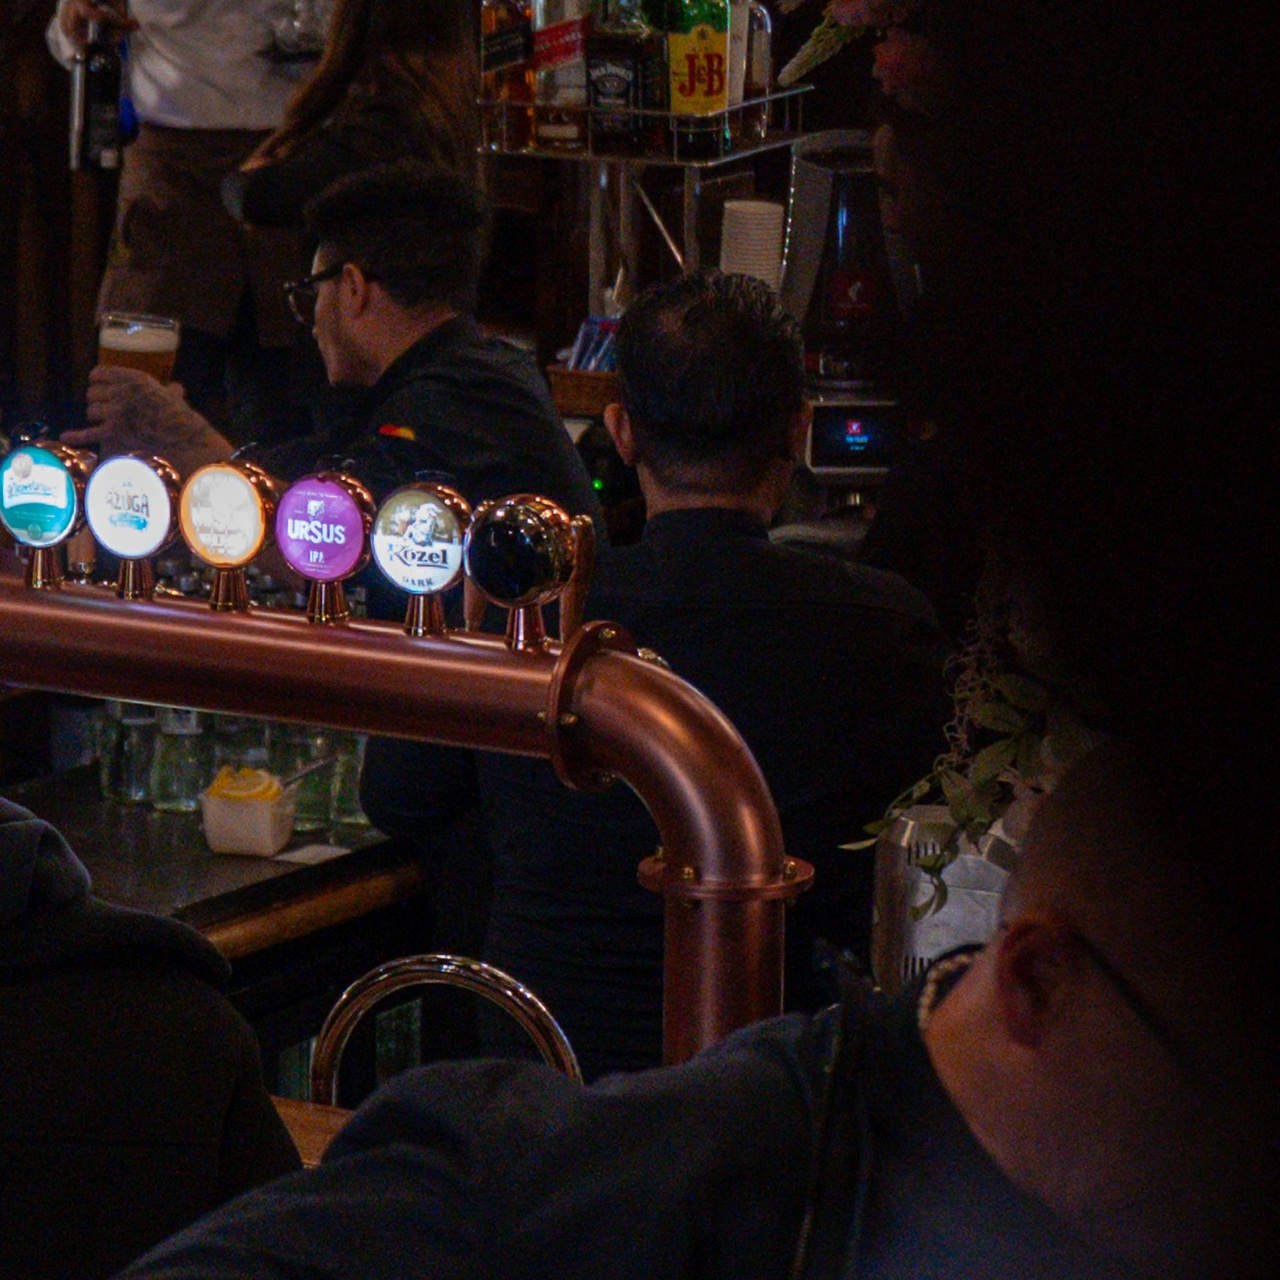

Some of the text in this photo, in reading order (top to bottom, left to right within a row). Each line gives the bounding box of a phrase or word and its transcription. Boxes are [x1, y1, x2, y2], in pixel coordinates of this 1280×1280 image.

[679, 53, 724, 97] J&B
[287, 518, 346, 545] URSUS
[309, 550, 324, 563] IPA
[388, 543, 449, 567] Kozel
